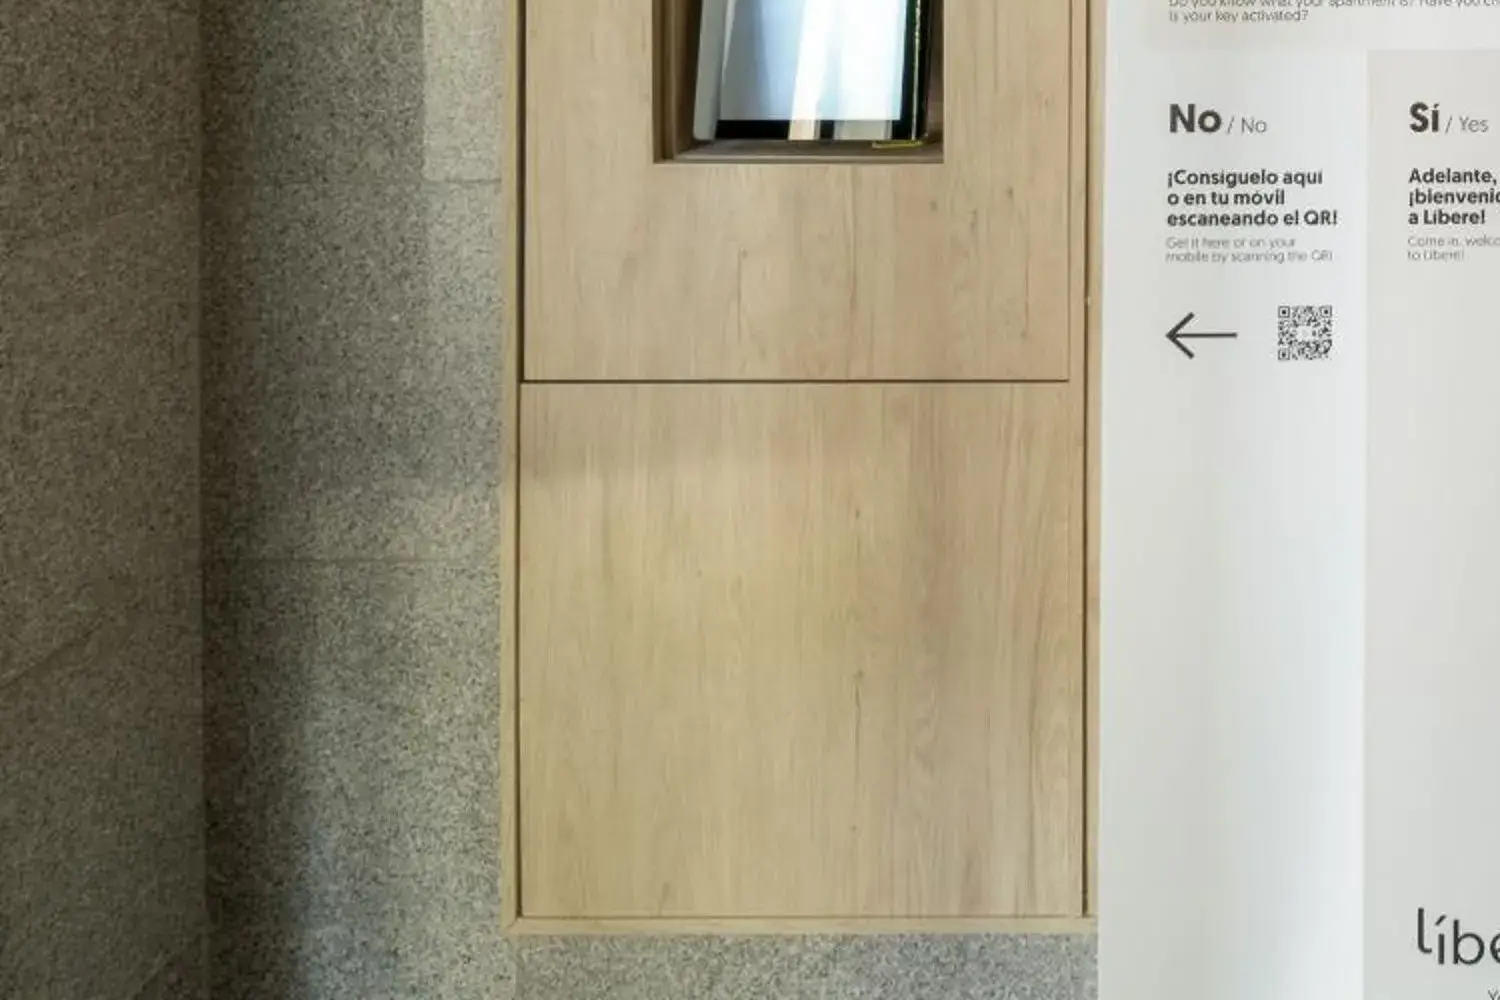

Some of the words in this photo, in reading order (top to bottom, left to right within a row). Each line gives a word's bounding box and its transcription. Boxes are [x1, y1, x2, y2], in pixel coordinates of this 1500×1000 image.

[1183, 12, 1212, 24] your
[1215, 11, 1238, 23] key
[1242, 10, 1309, 22] activated?
[1169, 103, 1222, 134] No
[1227, 117, 1234, 134] /
[1241, 118, 1268, 134] No
[1410, 102, 1439, 133] Sí
[1445, 116, 1453, 134] /
[1459, 117, 1488, 133] Yes
[1408, 168, 1497, 185] Adelante,
[1167, 193, 1179, 205] o
[1184, 193, 1206, 205] en
[1211, 191, 1229, 205] tu
[1234, 189, 1285, 205] móvil
[1167, 210, 1279, 226] escaneando
[1284, 210, 1299, 226] el
[1304, 210, 1337, 226] QR!
[1408, 213, 1418, 224] a
[1166, 237, 1188, 248] Get
[1202, 237, 1229, 248] here
[1233, 238, 1246, 248] or
[1249, 239, 1265, 248] on
[1269, 238, 1296, 251] your
[1408, 236, 1445, 247] Come
[1166, 251, 1208, 262] mobile
[1212, 252, 1228, 264] by
[1231, 251, 1284, 264] scanning
[1407, 251, 1421, 261] to
